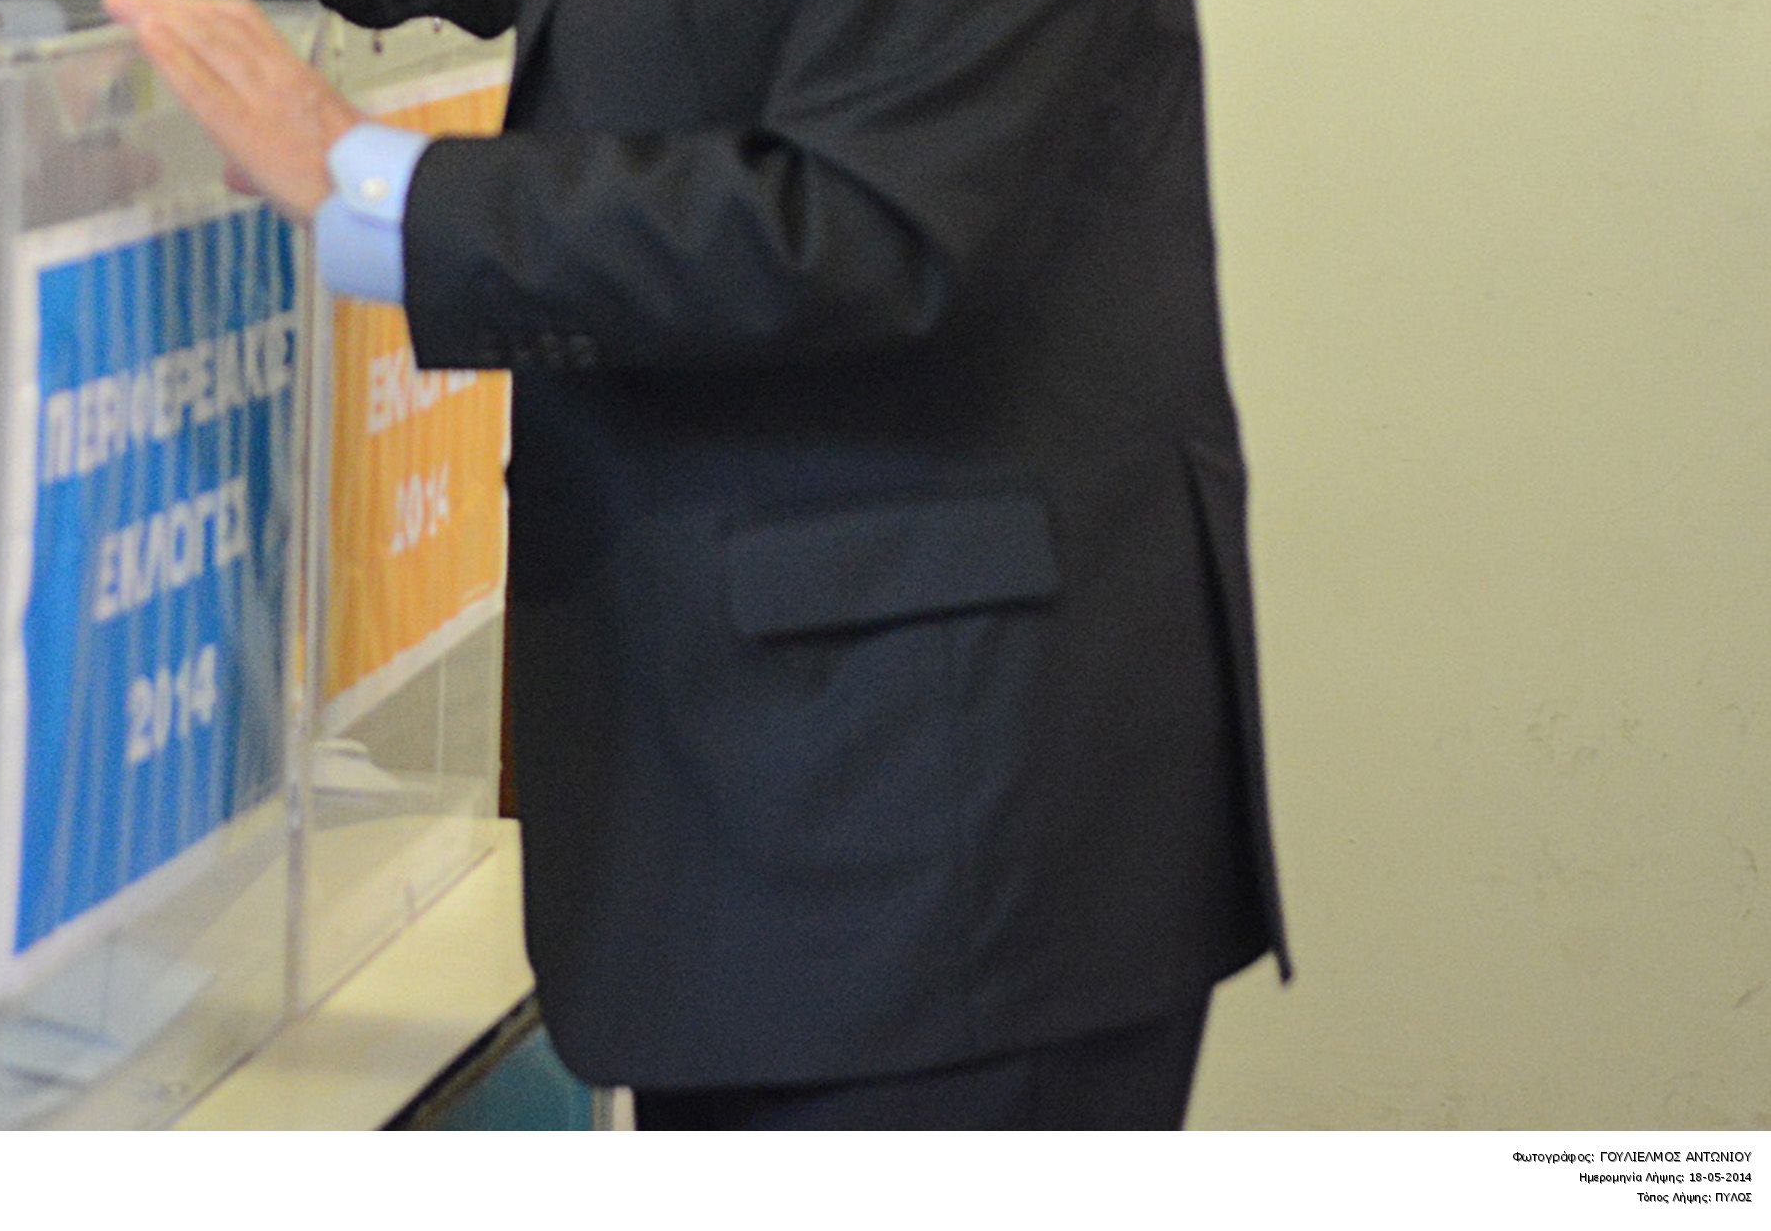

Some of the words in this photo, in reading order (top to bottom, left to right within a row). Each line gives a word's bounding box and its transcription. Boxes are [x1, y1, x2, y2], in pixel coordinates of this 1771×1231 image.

[94, 475, 249, 618] ΕΚΛΟΓΕΣ
[391, 462, 450, 556] 2014
[127, 644, 216, 762] 2014
